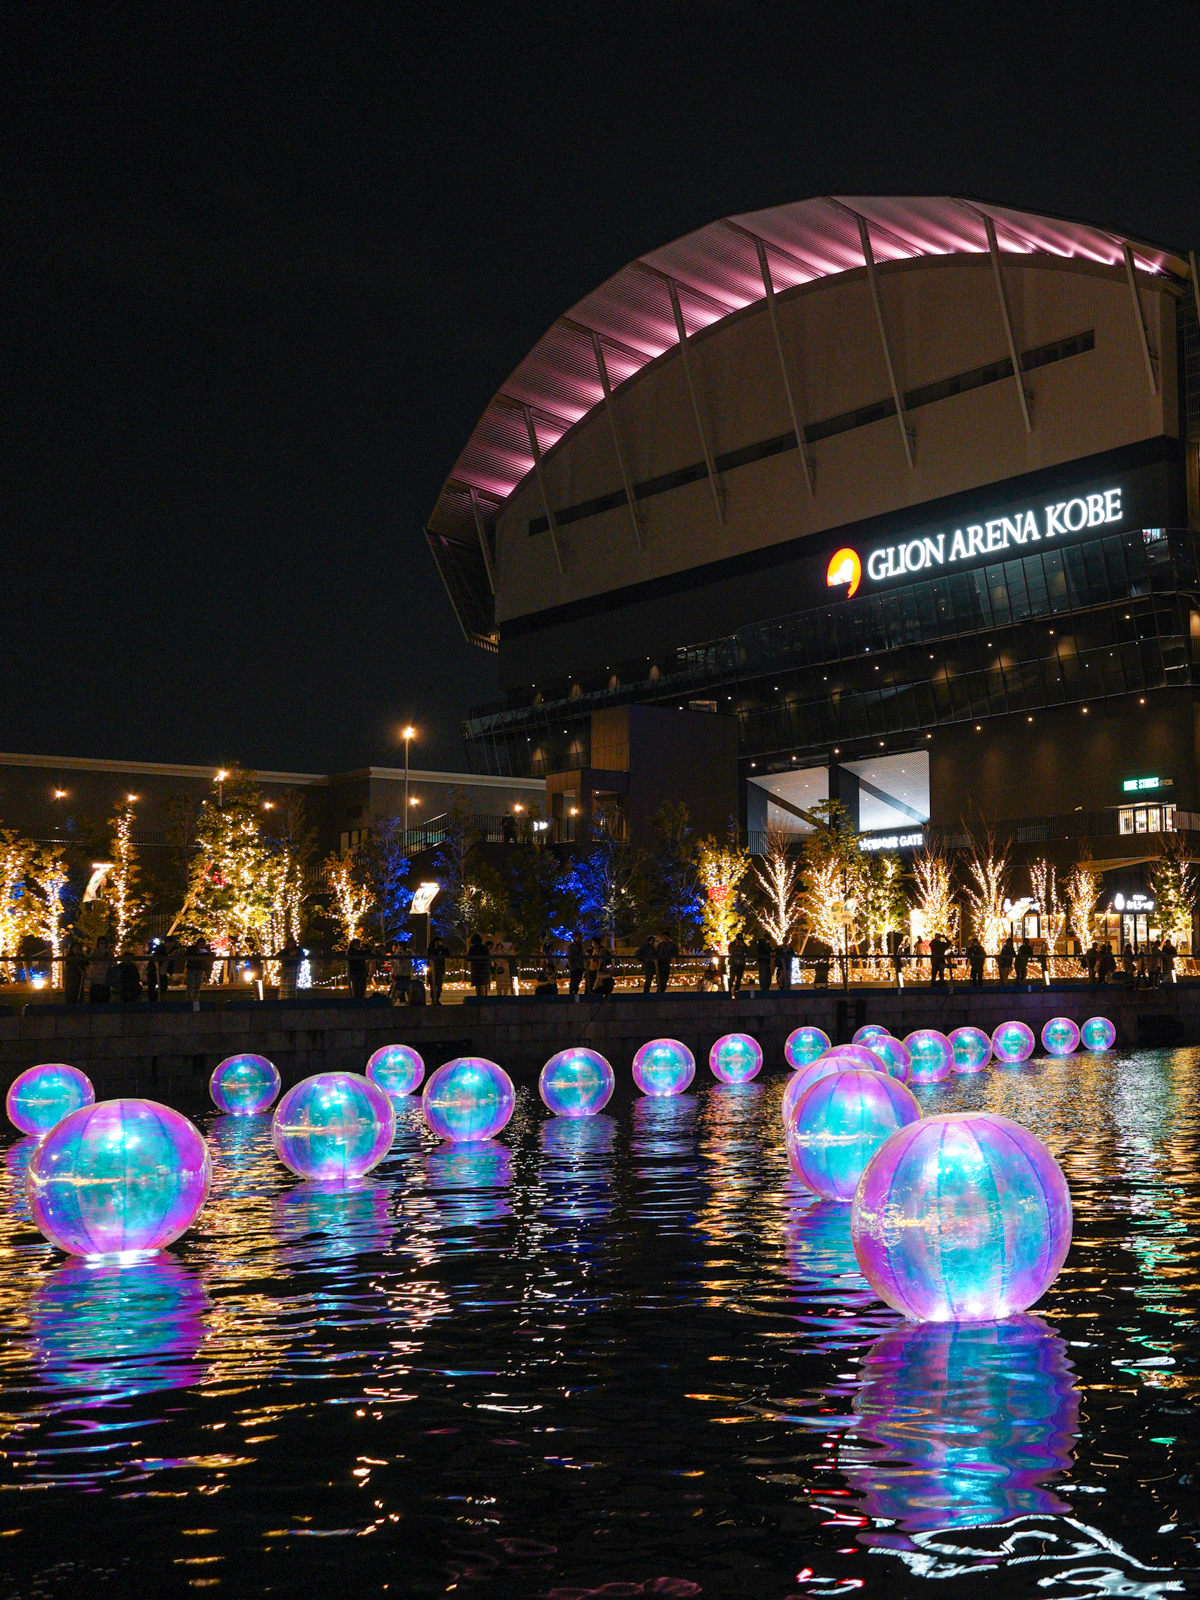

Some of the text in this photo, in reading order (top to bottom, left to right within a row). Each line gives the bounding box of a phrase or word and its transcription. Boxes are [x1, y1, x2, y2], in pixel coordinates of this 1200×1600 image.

[867, 487, 1124, 581] GLION ARENA KOBE
[899, 833, 923, 847] GATE
